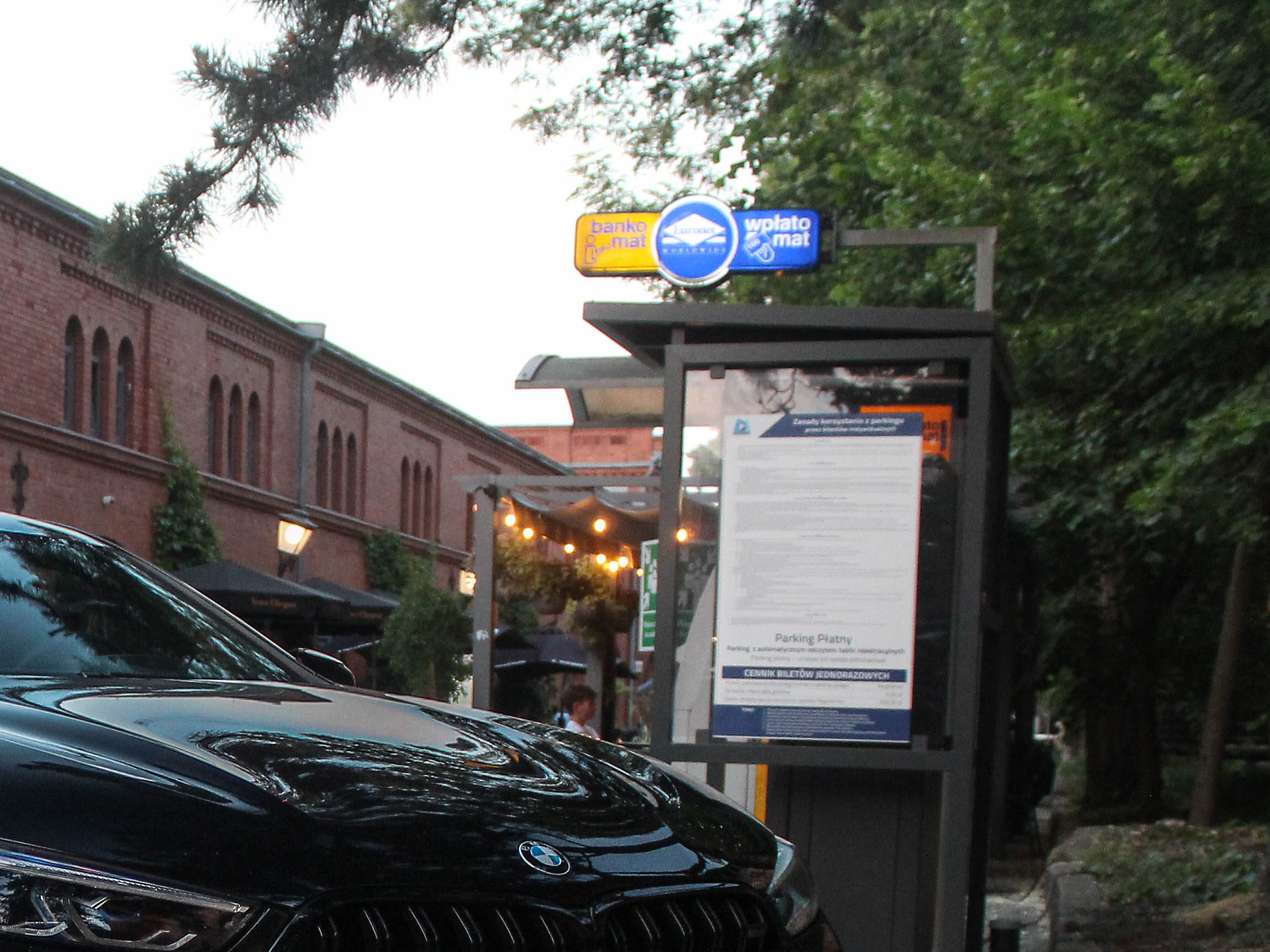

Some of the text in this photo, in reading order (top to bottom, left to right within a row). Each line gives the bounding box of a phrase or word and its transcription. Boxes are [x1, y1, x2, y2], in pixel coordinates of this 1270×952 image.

[590, 219, 648, 235] banko
[611, 232, 647, 249] mat
[772, 231, 811, 247] mat
[792, 417, 820, 426] Zasady
[820, 417, 864, 426] korzystania
[870, 417, 906, 426] parkingu
[775, 633, 853, 646] Parking Płatny
[726, 645, 750, 653] Parking
[743, 667, 891, 680] CENNIK BILETÓW JEDNORAZOWYCH
